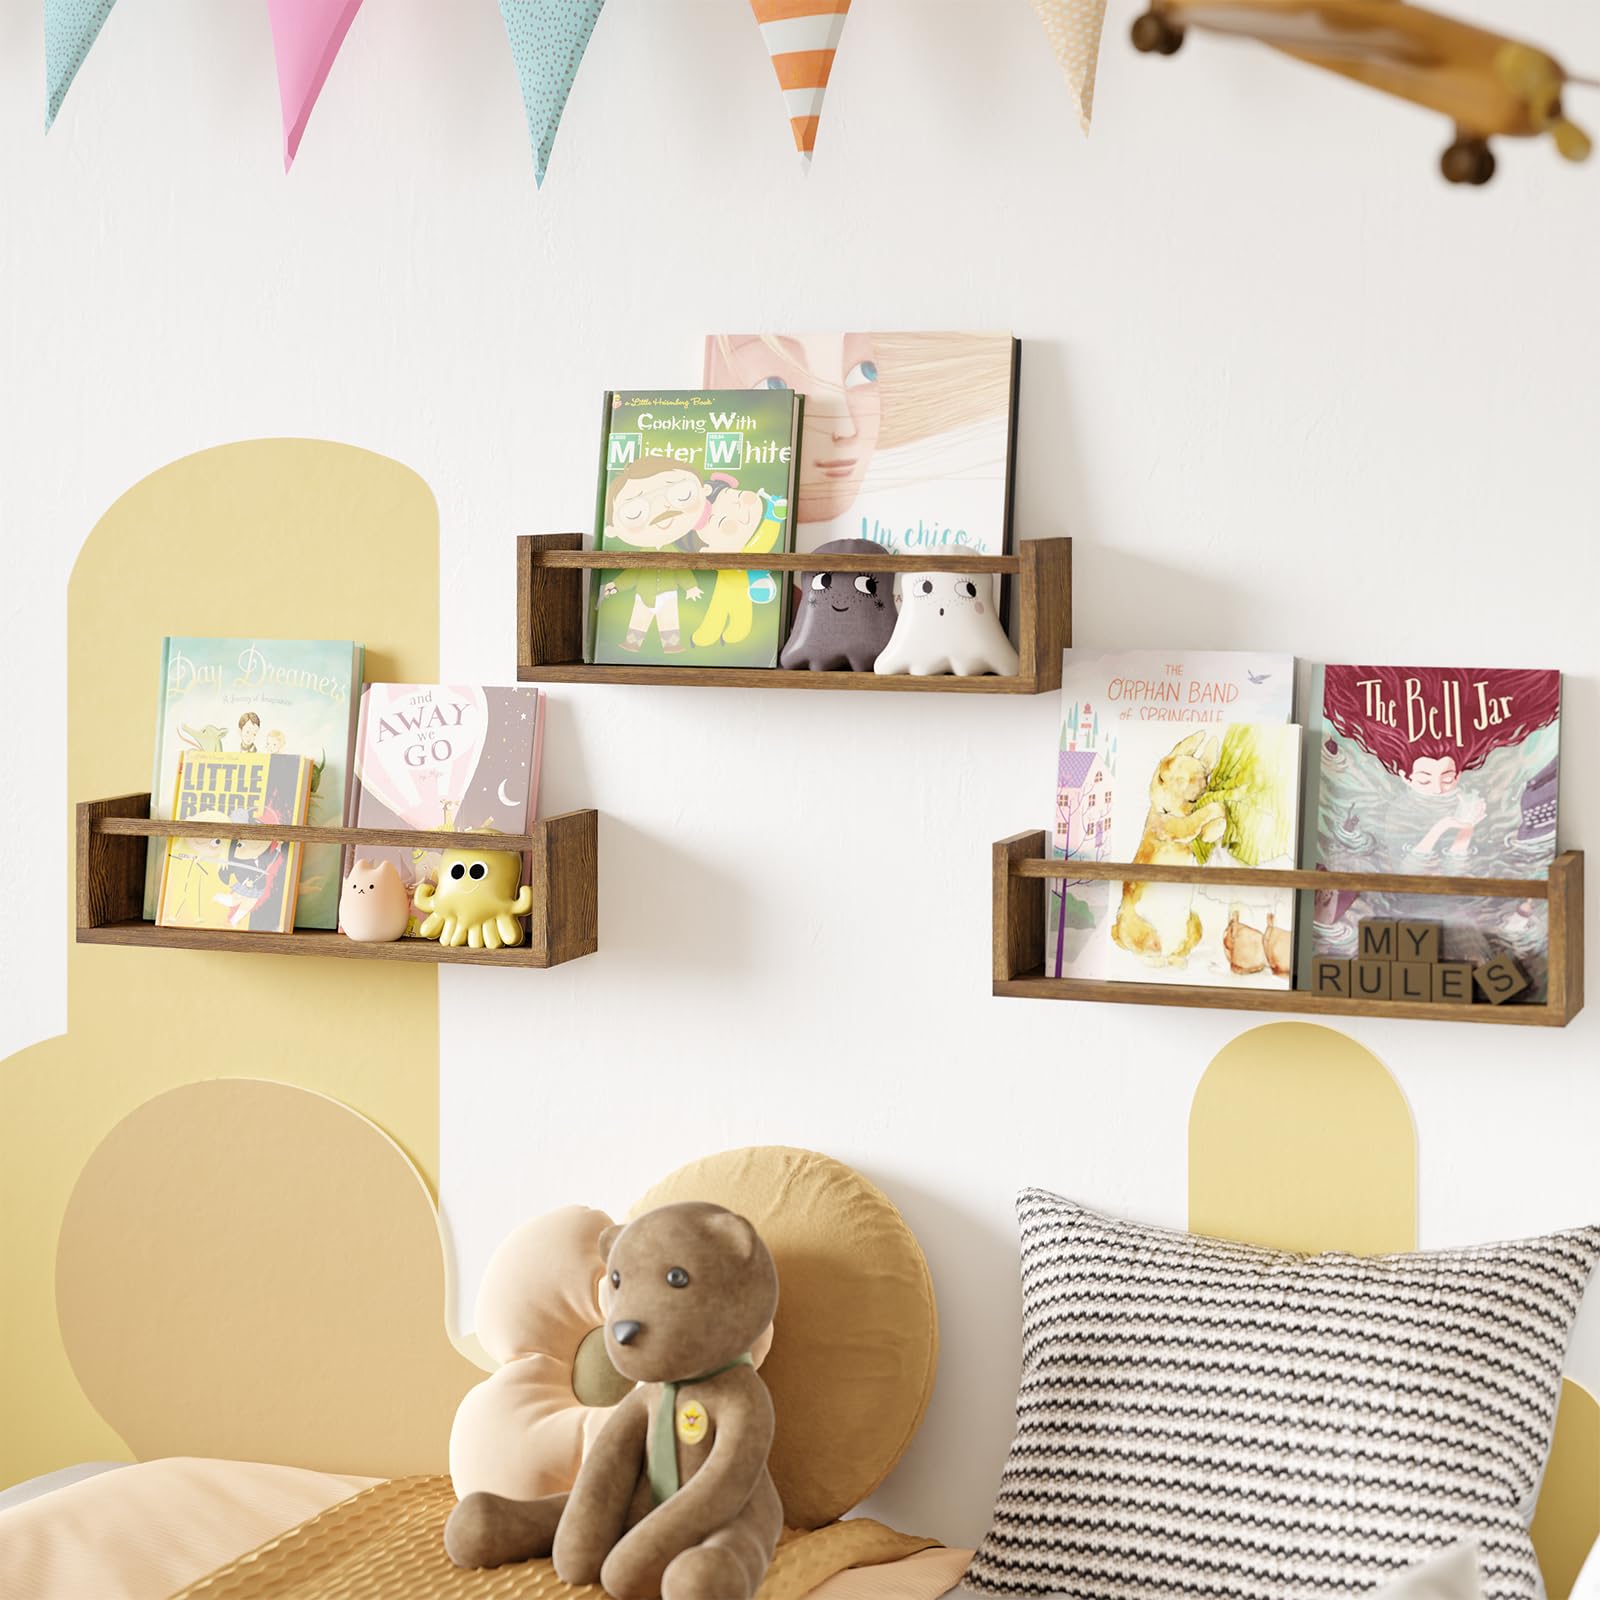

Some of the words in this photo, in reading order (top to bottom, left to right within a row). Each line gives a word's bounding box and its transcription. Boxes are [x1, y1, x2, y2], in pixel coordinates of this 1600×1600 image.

[637, 412, 707, 434] Cooking
[708, 411, 757, 430] With
[610, 440, 703, 464] Mister
[708, 439, 791, 464] White
[861, 516, 898, 549] Un
[904, 519, 973, 548] chico
[974, 537, 990, 553] de
[167, 650, 222, 697] Day
[234, 642, 350, 705] Dreamers
[1165, 664, 1184, 676] THE
[409, 690, 433, 705] and
[1107, 677, 1181, 702] ORPHAN
[1188, 681, 1240, 704] BAND
[377, 702, 472, 743] AWAY
[1119, 707, 1133, 721] of
[1356, 679, 1397, 729] The
[1405, 677, 1464, 747] Bell
[1473, 681, 1514, 731] Jar
[417, 730, 436, 742] we
[403, 739, 453, 767] GO
[183, 762, 264, 793] LITTLE
[1364, 926, 1430, 957] MY
[1318, 963, 1514, 999] RULES
